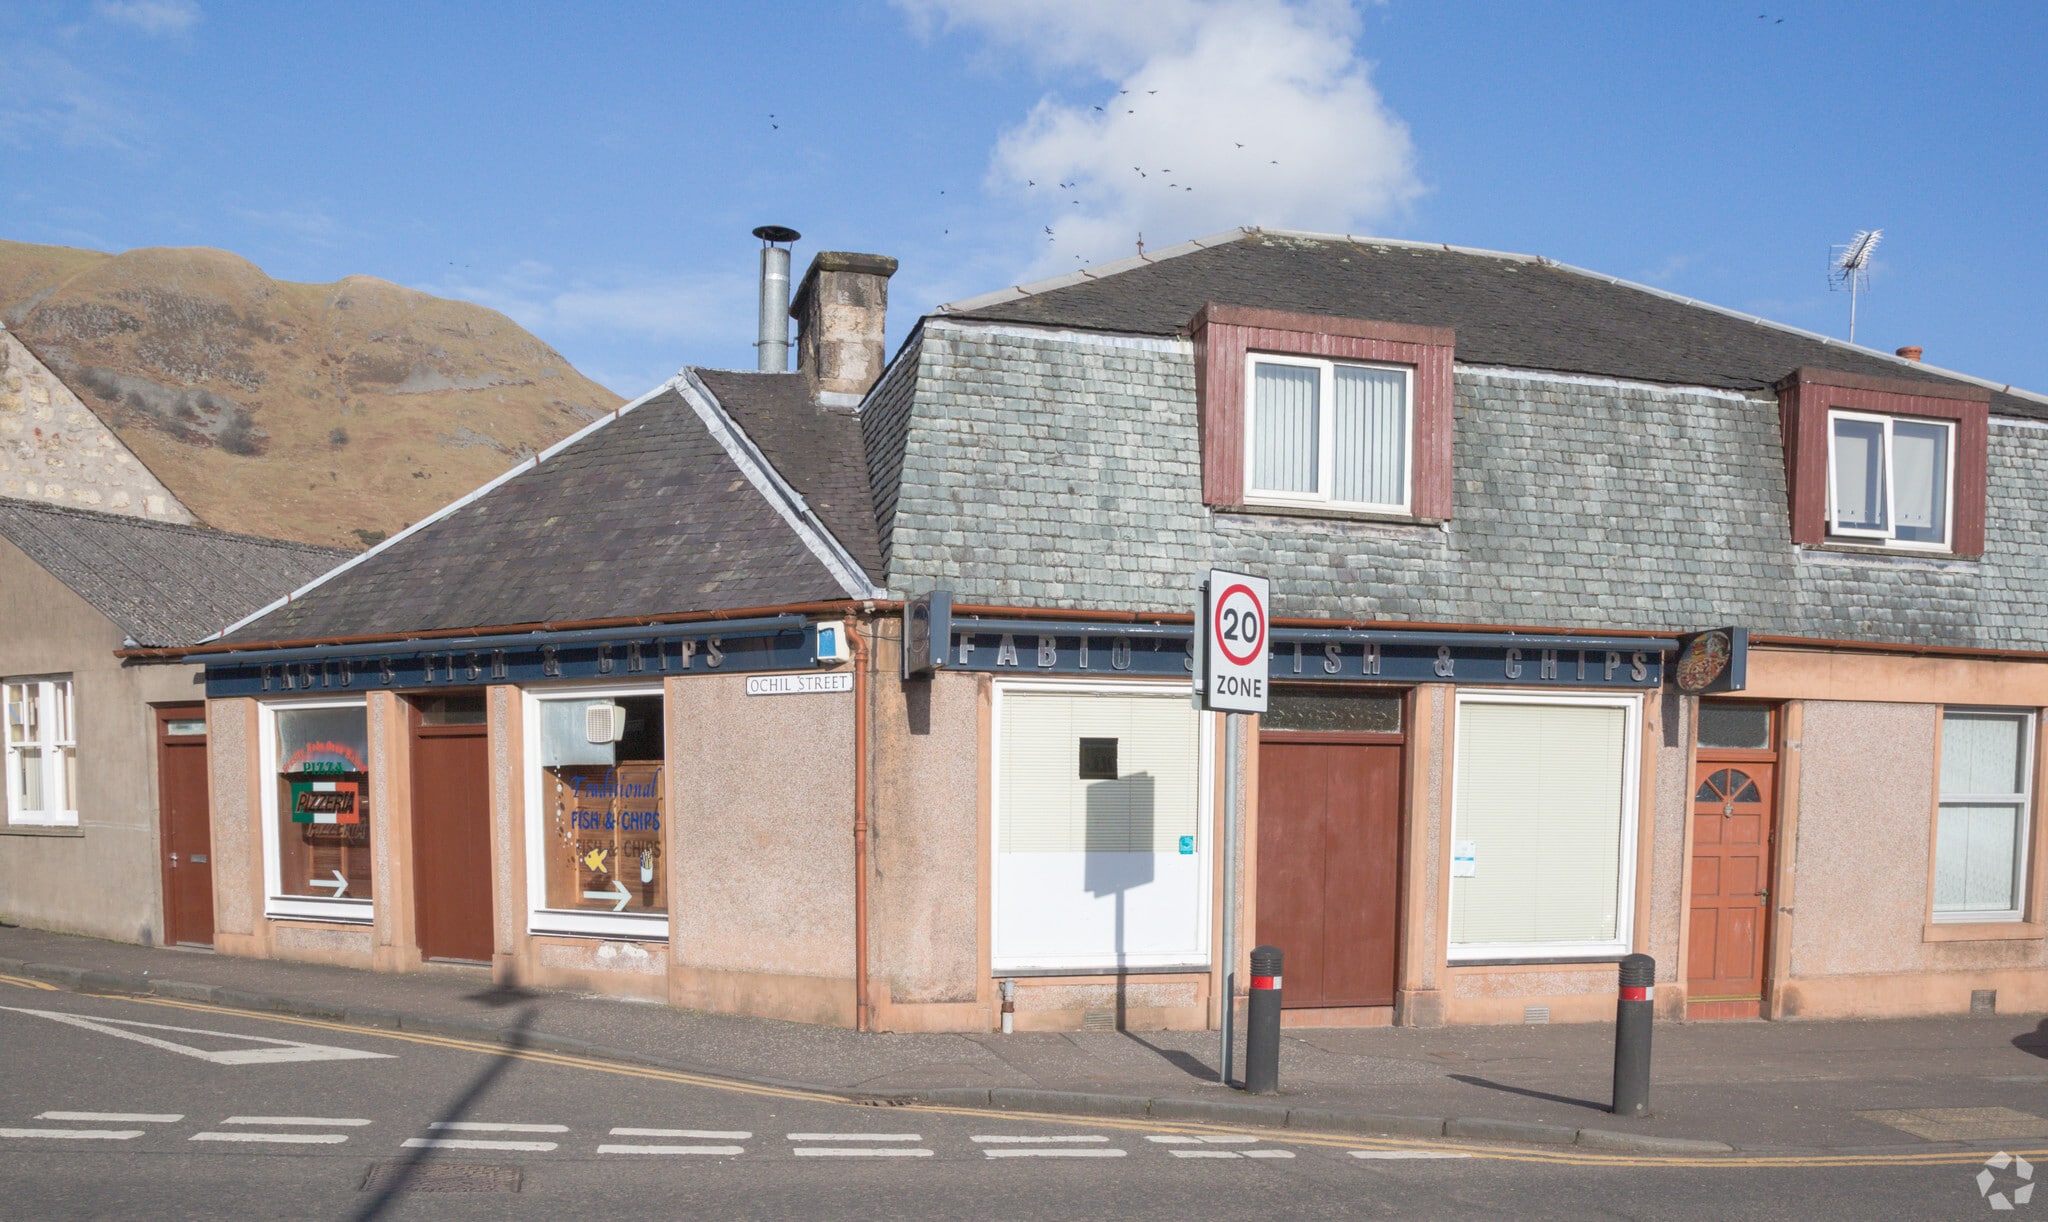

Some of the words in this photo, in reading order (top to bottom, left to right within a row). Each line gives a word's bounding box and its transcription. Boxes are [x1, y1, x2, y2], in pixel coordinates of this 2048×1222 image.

[1223, 607, 1257, 643] 20
[261, 655, 395, 690] FABIO'S
[424, 650, 506, 682] FISH
[600, 634, 723, 674] CHIPS
[1433, 645, 1455, 677] &
[1505, 646, 1647, 683] CHIPS
[750, 678, 791, 692] OCHIL
[798, 675, 848, 691] STREET
[1217, 675, 1262, 698] ZONE
[303, 762, 344, 776] PIZZA
[570, 768, 662, 798] Traditional
[296, 791, 355, 814] PIZZERIA
[571, 811, 599, 829] FISH
[605, 811, 617, 830] &
[621, 811, 660, 831] CHIPS
